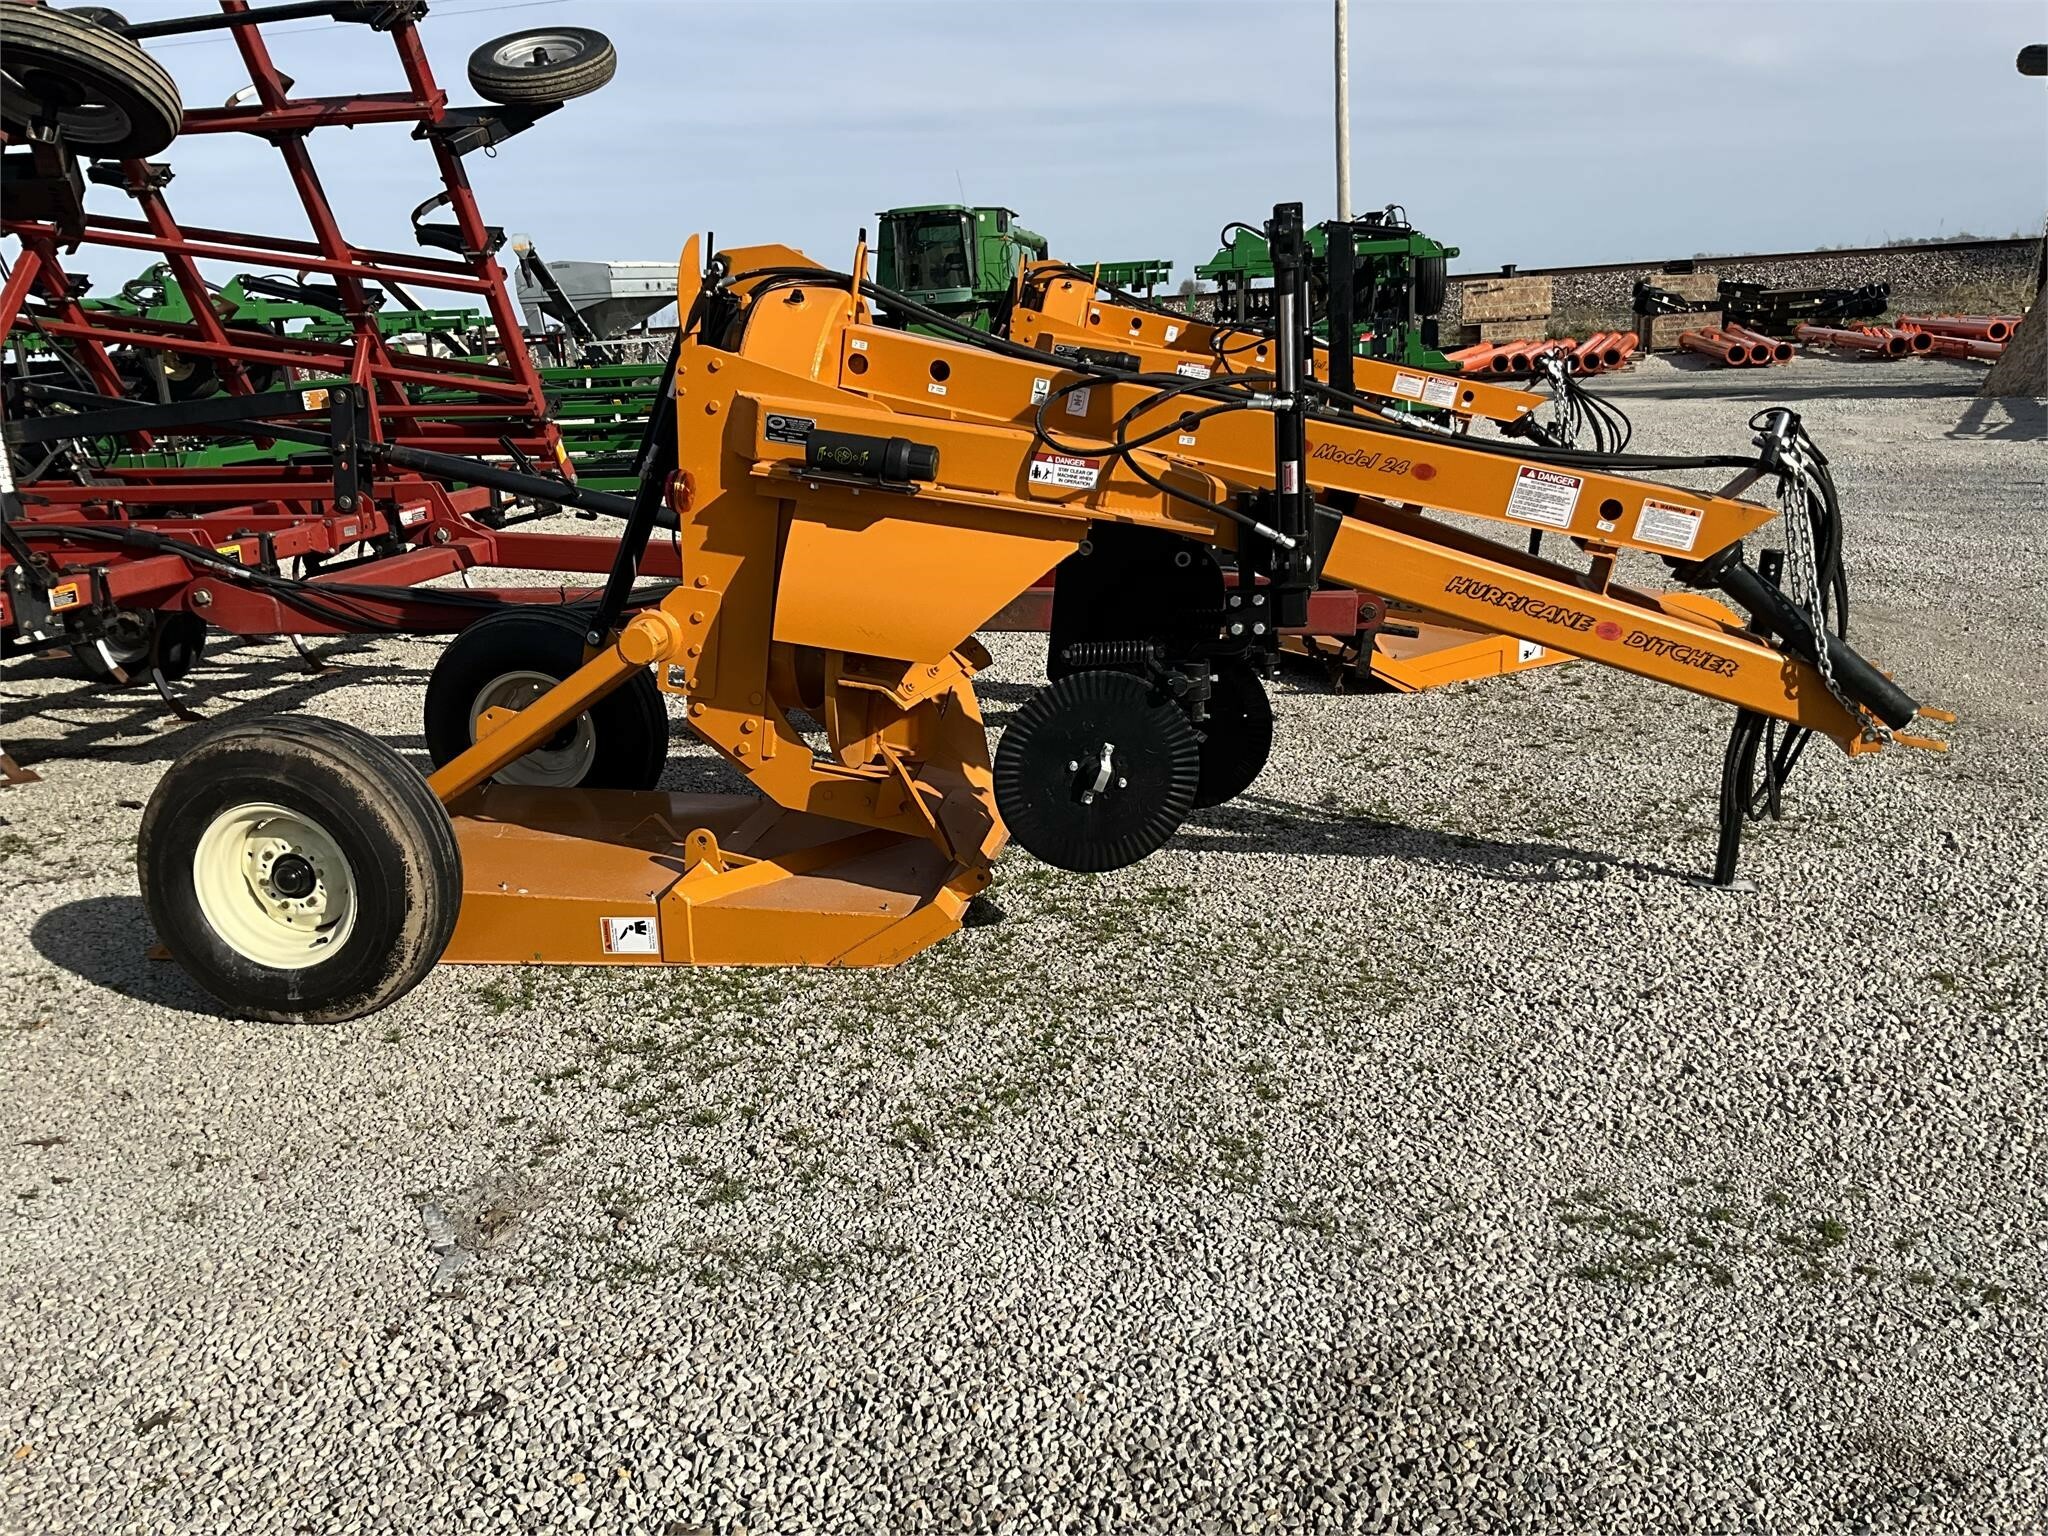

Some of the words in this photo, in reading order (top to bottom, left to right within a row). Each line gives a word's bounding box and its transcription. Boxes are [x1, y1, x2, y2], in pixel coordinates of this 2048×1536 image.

[1055, 456, 1085, 466] DANGER
[1313, 443, 1381, 468] Model
[1379, 457, 1411, 475] 24
[1057, 472, 1079, 480] MACHINE
[1537, 471, 1576, 487] DANGER
[1064, 478, 1091, 487] OPERATION
[1659, 503, 1687, 514] WARNING
[1445, 576, 1597, 632] HURRICANE
[1623, 630, 1739, 678] DITCHER
